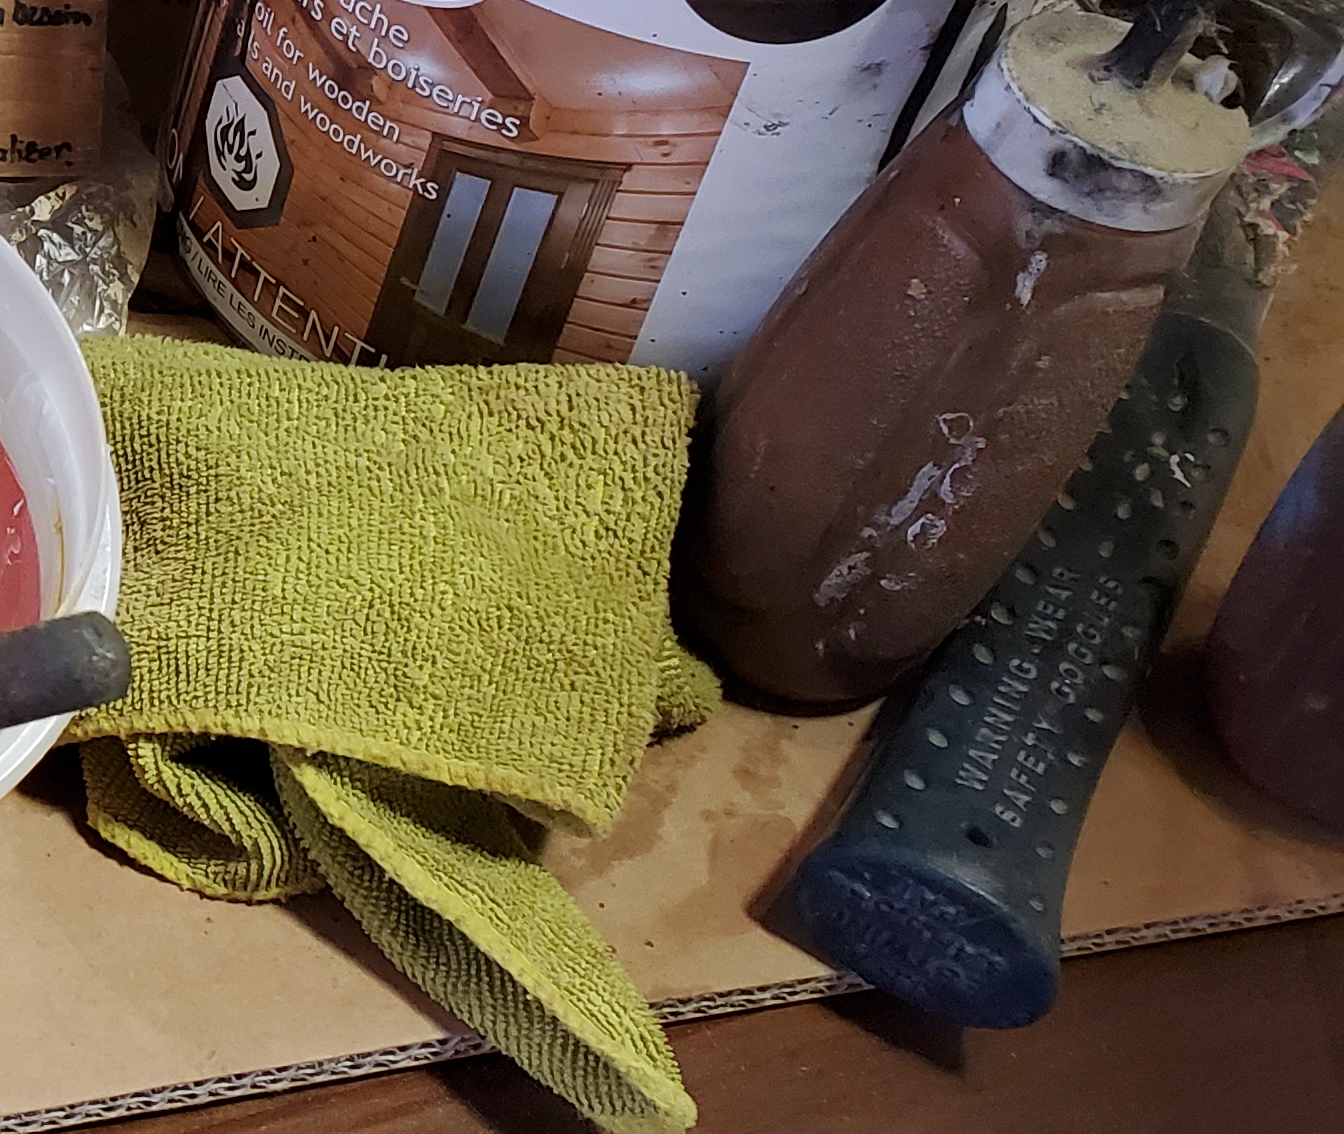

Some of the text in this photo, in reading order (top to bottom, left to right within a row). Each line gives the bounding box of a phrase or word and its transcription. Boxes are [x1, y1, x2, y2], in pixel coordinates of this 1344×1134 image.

[255, 1, 400, 143] oil for wooden
[262, 60, 440, 201] and woodworks
[330, 15, 360, 52] et
[368, 38, 522, 139] boiseries
[198, 258, 227, 299] LIRE
[229, 292, 256, 329] LES
[955, 566, 1080, 791] WARNING WEAR
[994, 713, 1060, 828] SAFETY
